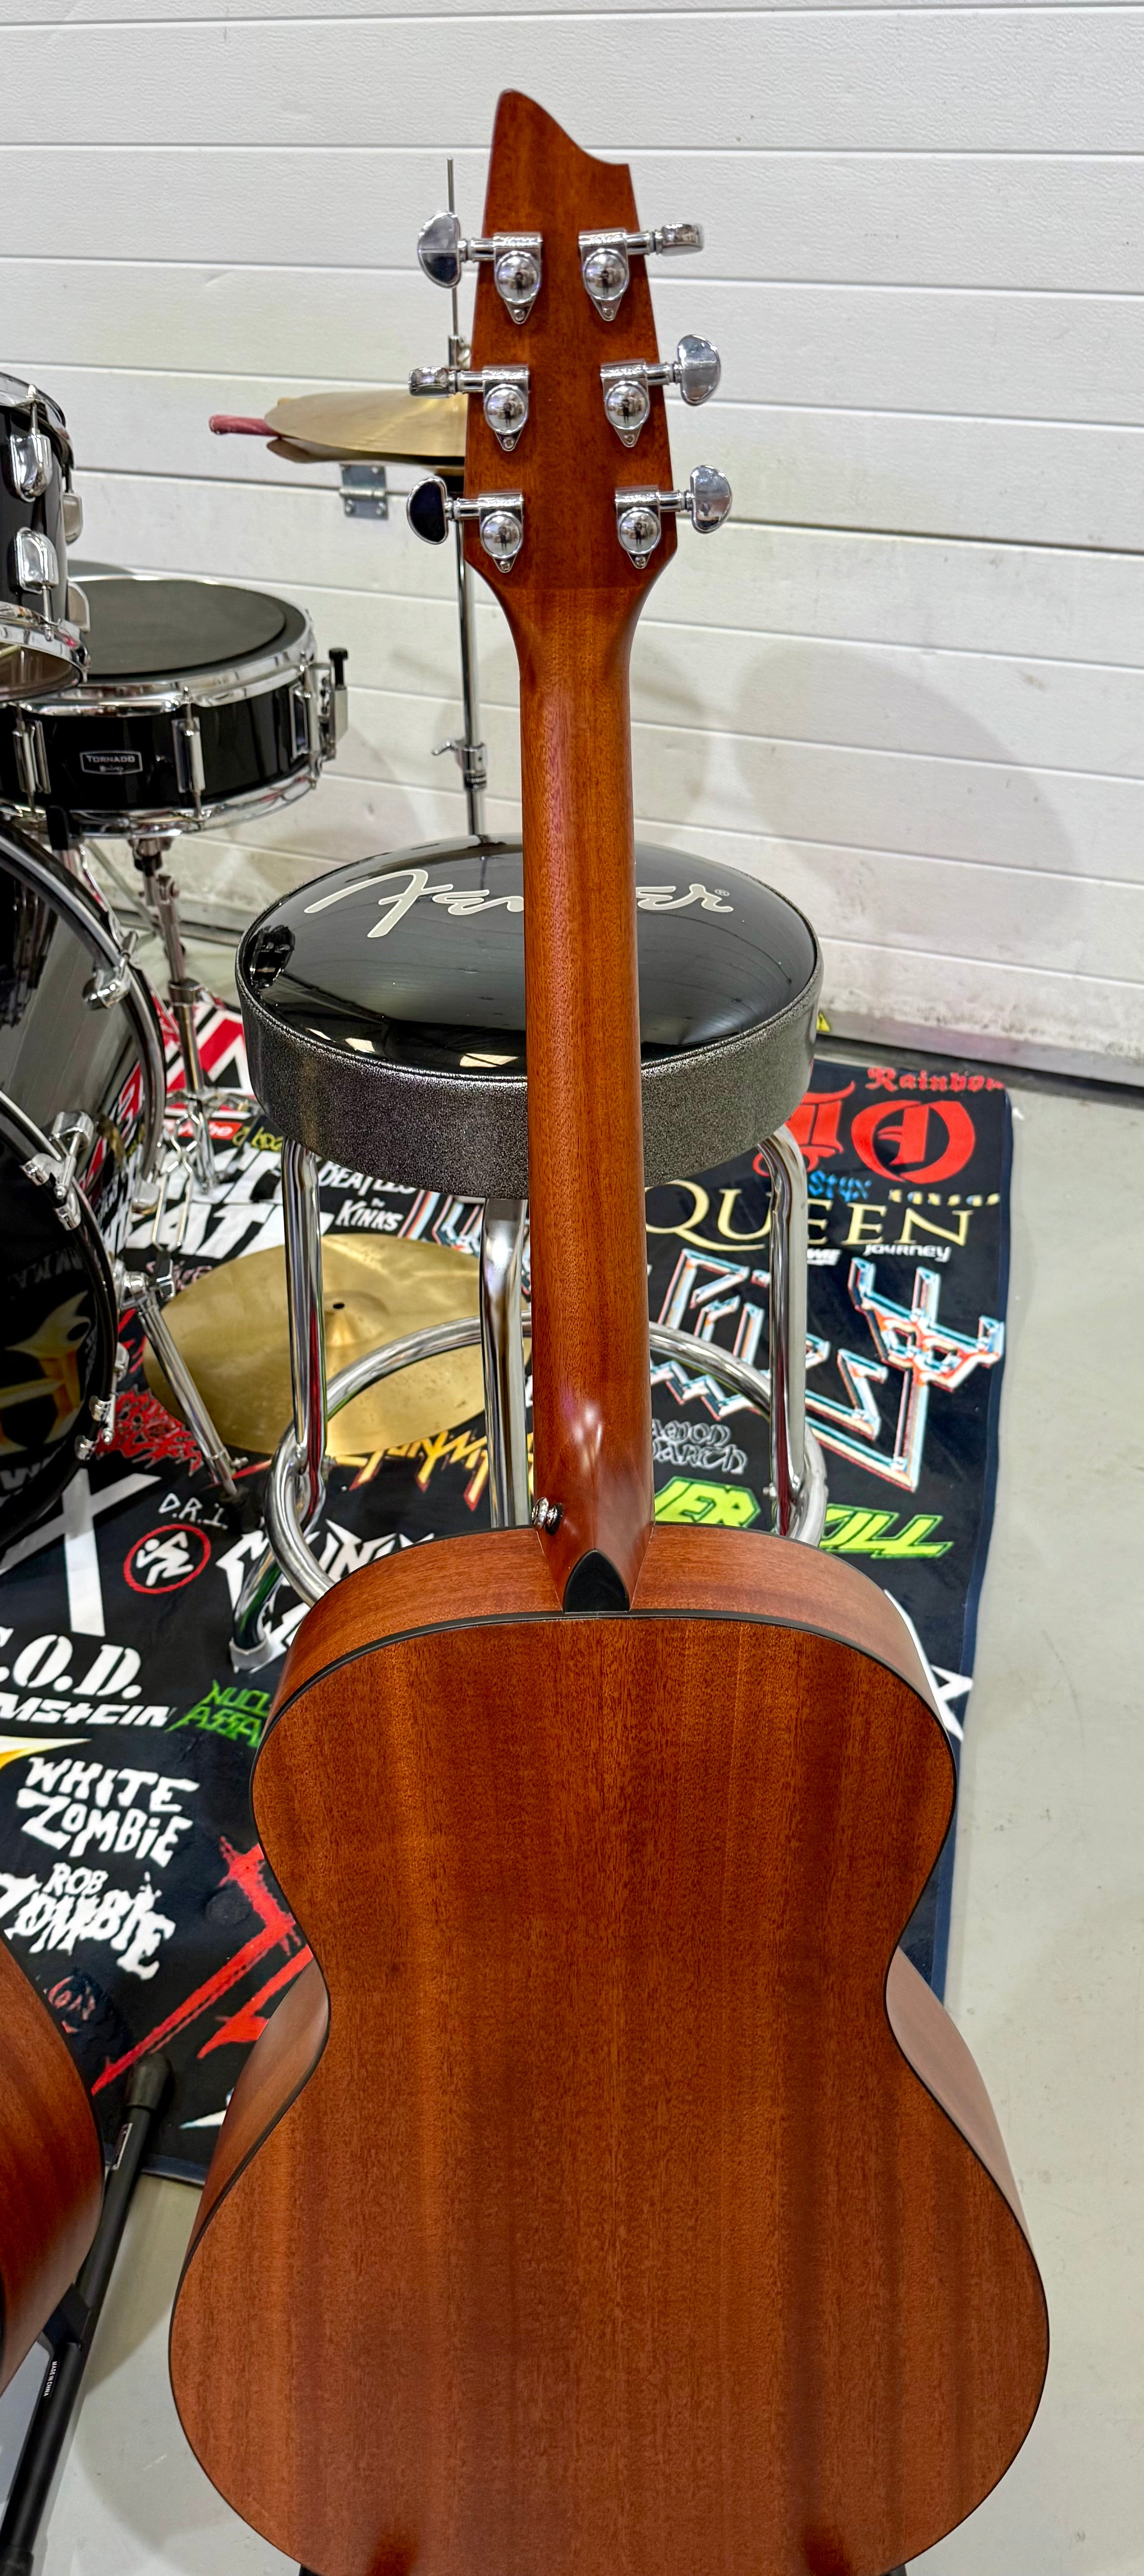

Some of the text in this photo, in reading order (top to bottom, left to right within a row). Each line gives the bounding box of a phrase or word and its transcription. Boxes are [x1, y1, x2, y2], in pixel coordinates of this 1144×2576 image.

[86, 755, 135, 763] TORNADO
[304, 869, 734, 938] Feer
[335, 1199, 404, 1232] KINKS
[25, 1757, 200, 1812] WHITE
[42, 1862, 109, 1896] ROB
